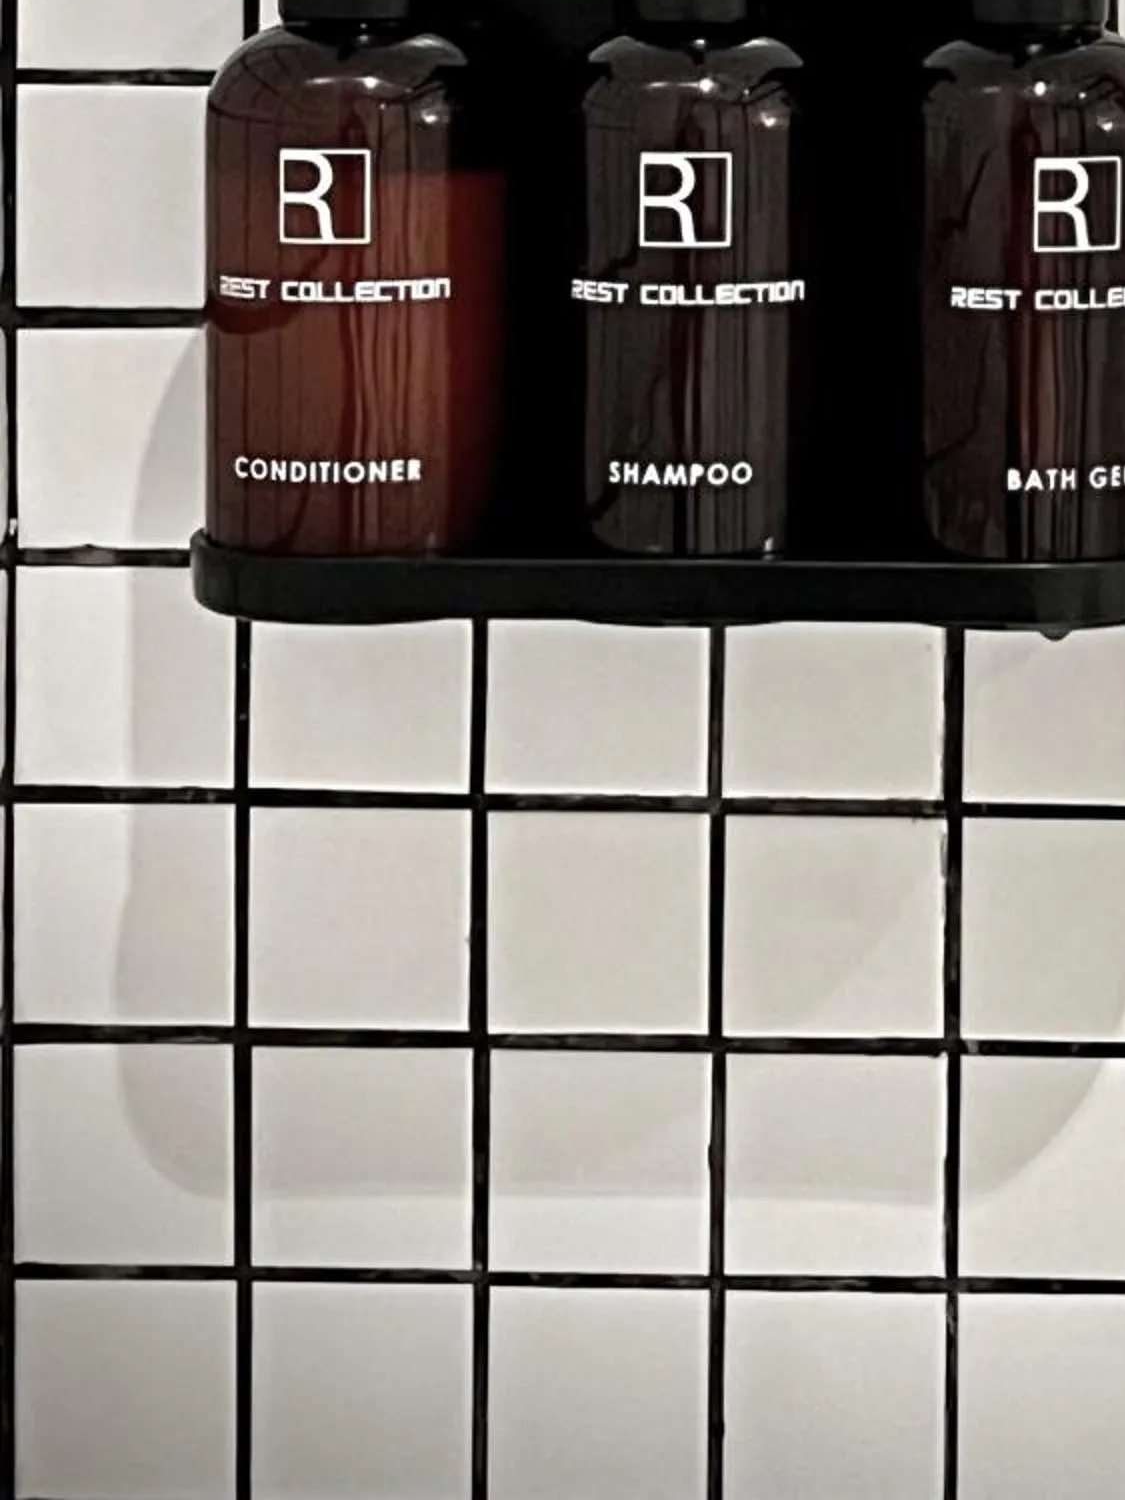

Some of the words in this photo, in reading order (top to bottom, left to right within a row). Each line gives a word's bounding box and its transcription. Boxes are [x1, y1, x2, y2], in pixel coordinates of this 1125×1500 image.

[219, 275, 271, 300] REST
[280, 277, 451, 303] COLLECTION
[571, 278, 629, 304] REST
[639, 279, 805, 306] COLLECTION
[950, 286, 1022, 311] REST
[234, 455, 422, 484] CONDITIONER
[608, 461, 753, 487] SHAMPOO
[1007, 467, 1077, 492] BATH
